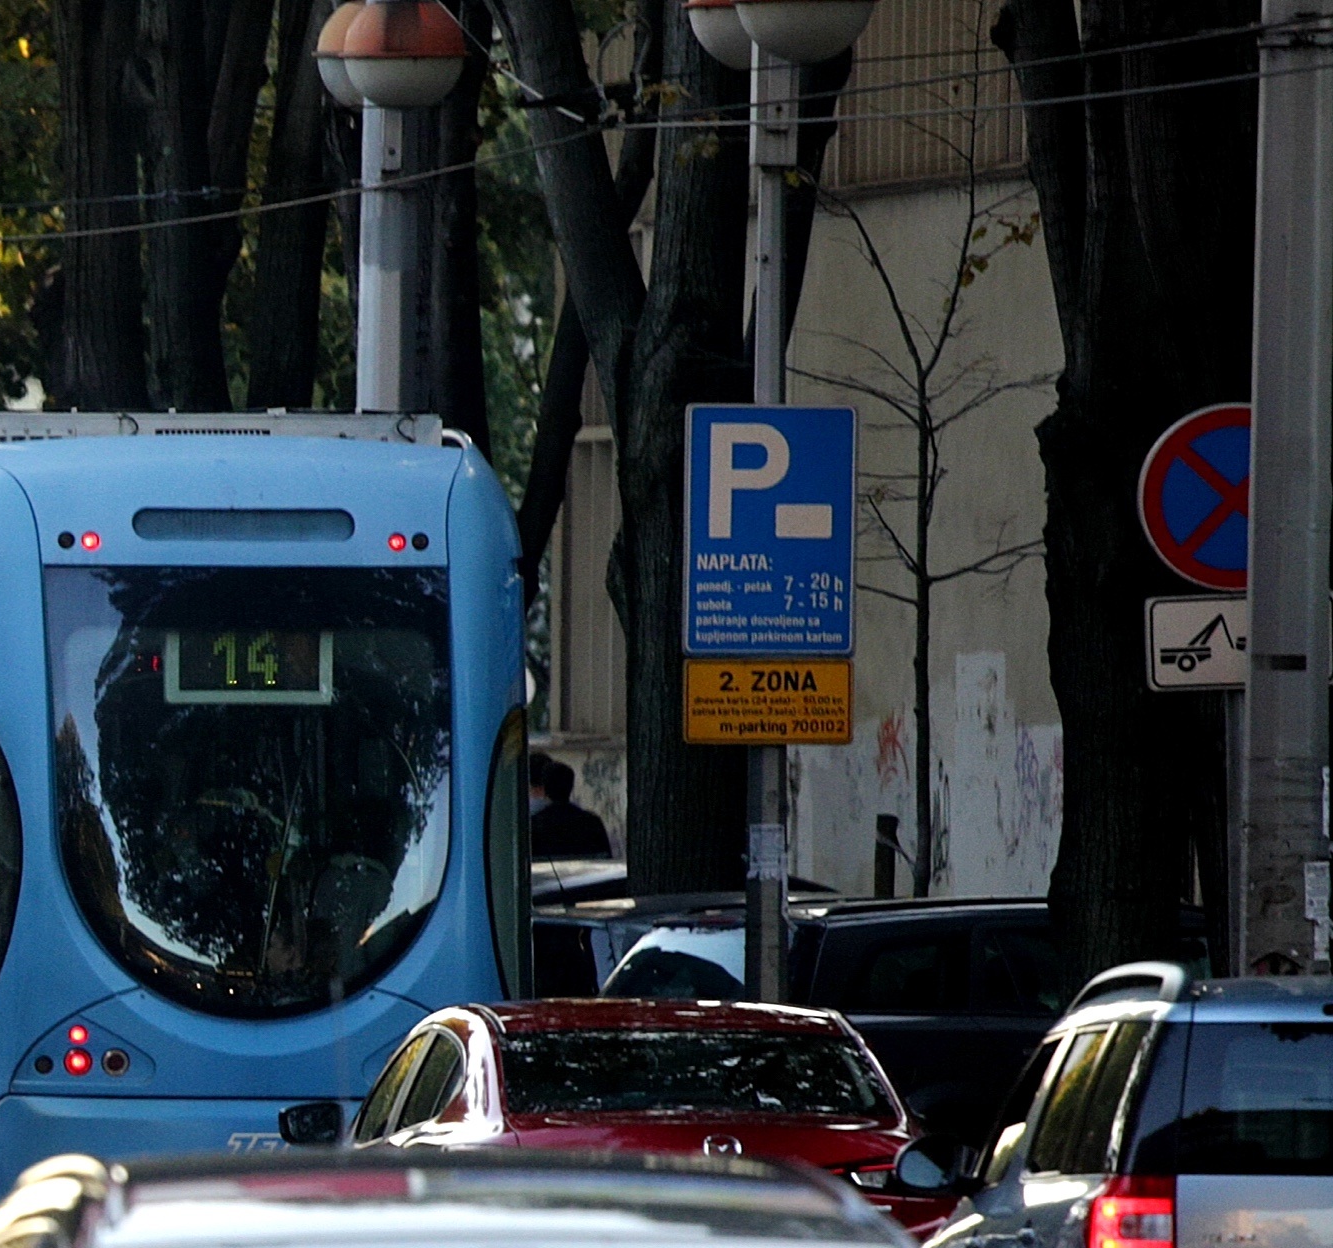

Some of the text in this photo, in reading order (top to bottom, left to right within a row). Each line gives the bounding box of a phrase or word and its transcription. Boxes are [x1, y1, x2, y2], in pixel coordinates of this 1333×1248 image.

[709, 423, 790, 539] P
[696, 553, 773, 571] NAPLATA:
[696, 581, 734, 594] ponedj.
[744, 581, 773, 594] petak
[784, 575, 793, 592] 7
[810, 572, 830, 590] 20
[834, 575, 843, 592] h
[696, 599, 732, 611] subota
[784, 594, 793, 611] 7
[810, 591, 828, 609] 15
[834, 594, 843, 611] h
[696, 614, 820, 629] parkiranje dozvoljeno sa
[696, 630, 843, 644] kupljenom parkirnom kartom
[214, 631, 279, 686] 14
[719, 671, 817, 692] 2. ZONA
[720, 719, 845, 735] m-parking 700102
